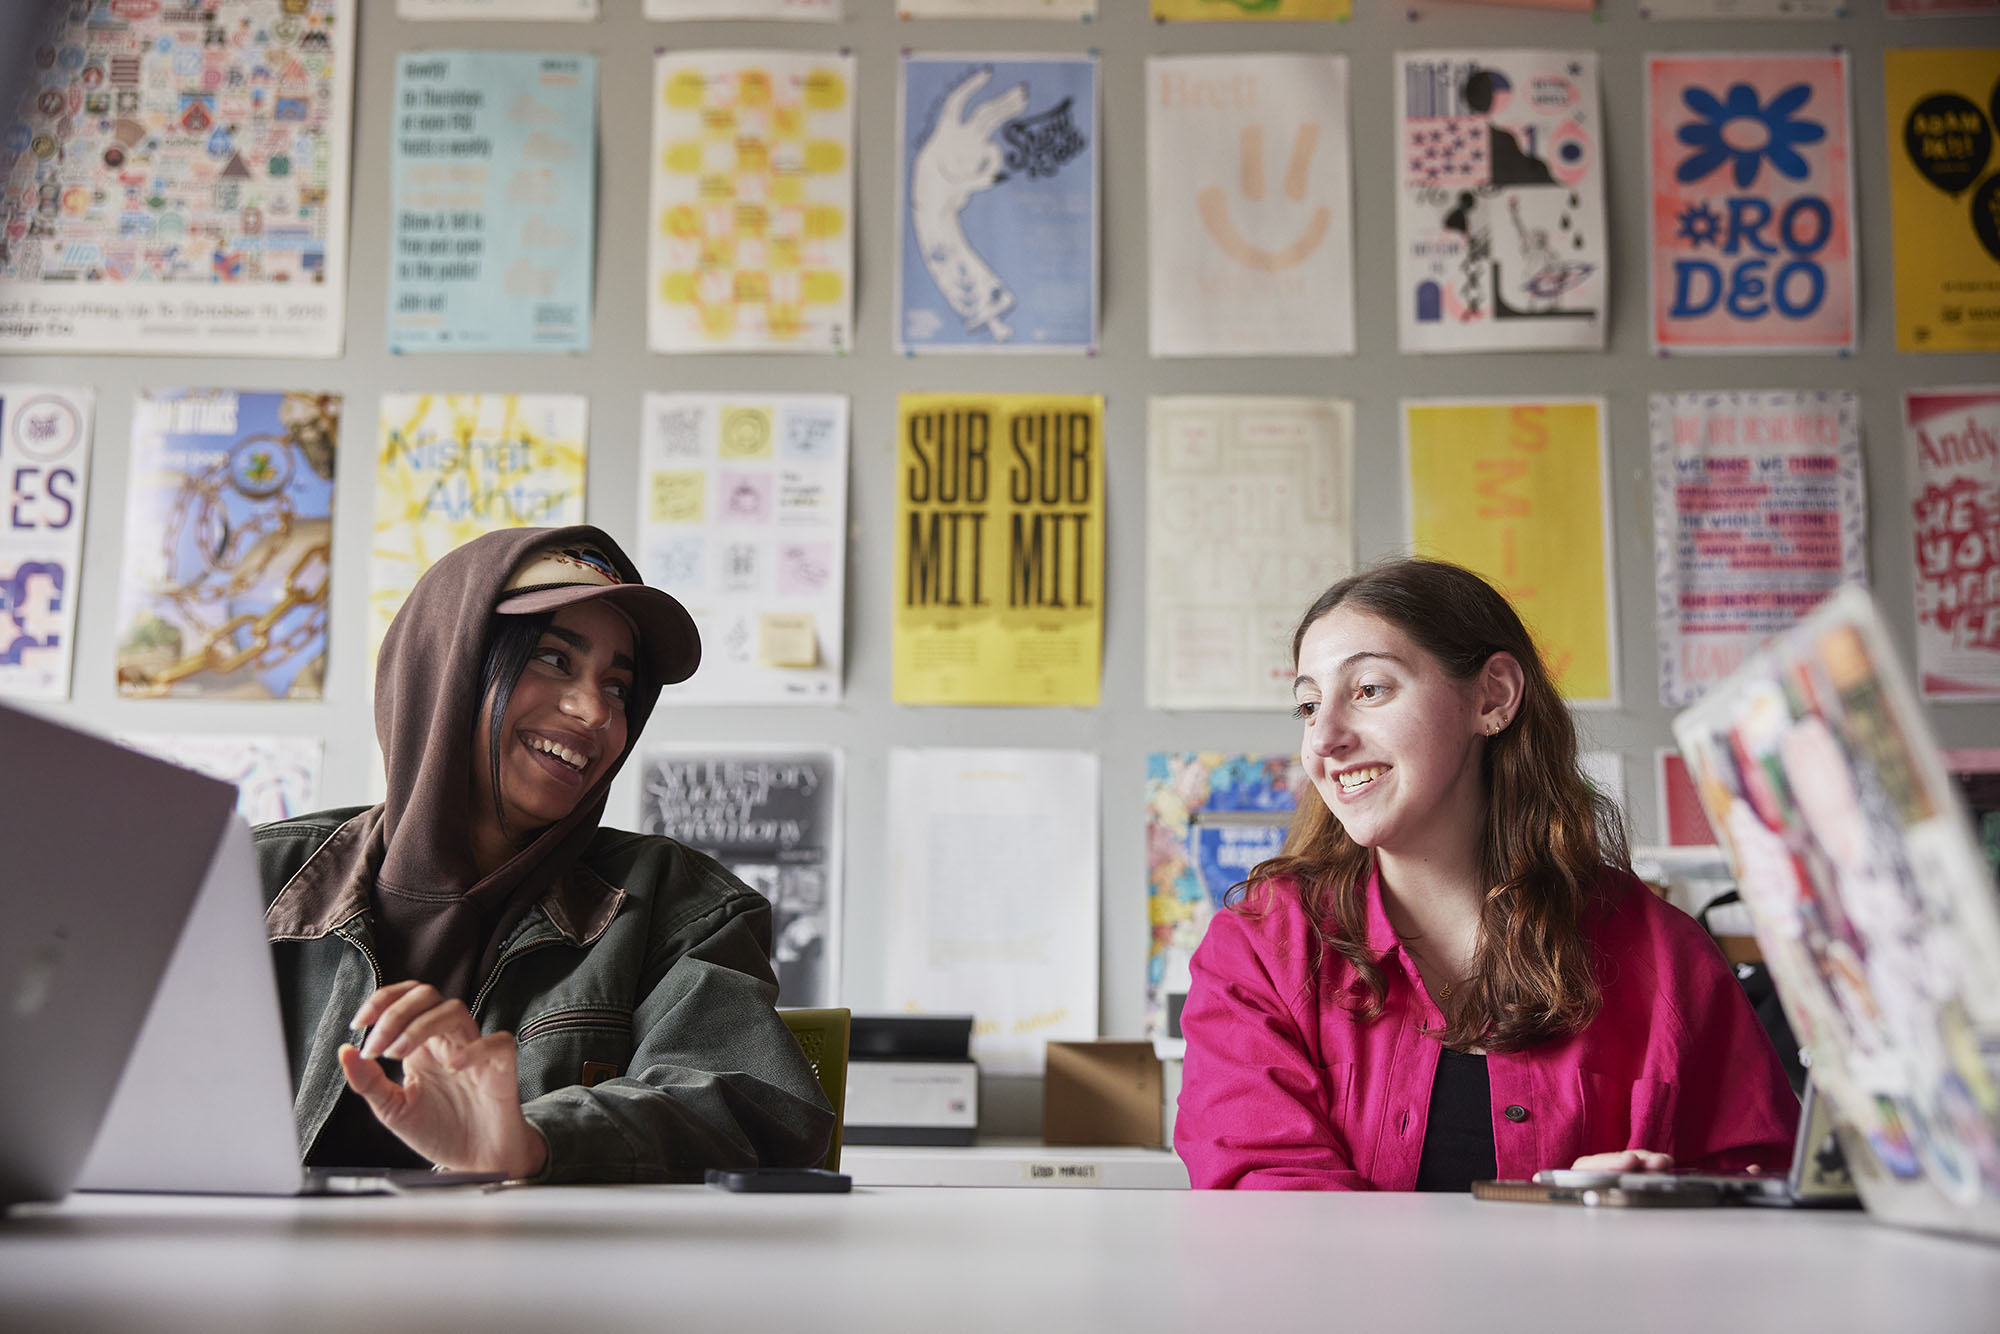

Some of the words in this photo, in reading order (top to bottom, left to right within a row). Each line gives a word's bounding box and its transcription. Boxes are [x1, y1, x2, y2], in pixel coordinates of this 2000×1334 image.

[1722, 196, 1834, 257] RO
[1668, 259, 1829, 322] DEO
[907, 411, 989, 504] SUB
[1010, 411, 1092, 505] SUB
[907, 510, 989, 608] MIT
[1009, 511, 1093, 609] MIT
